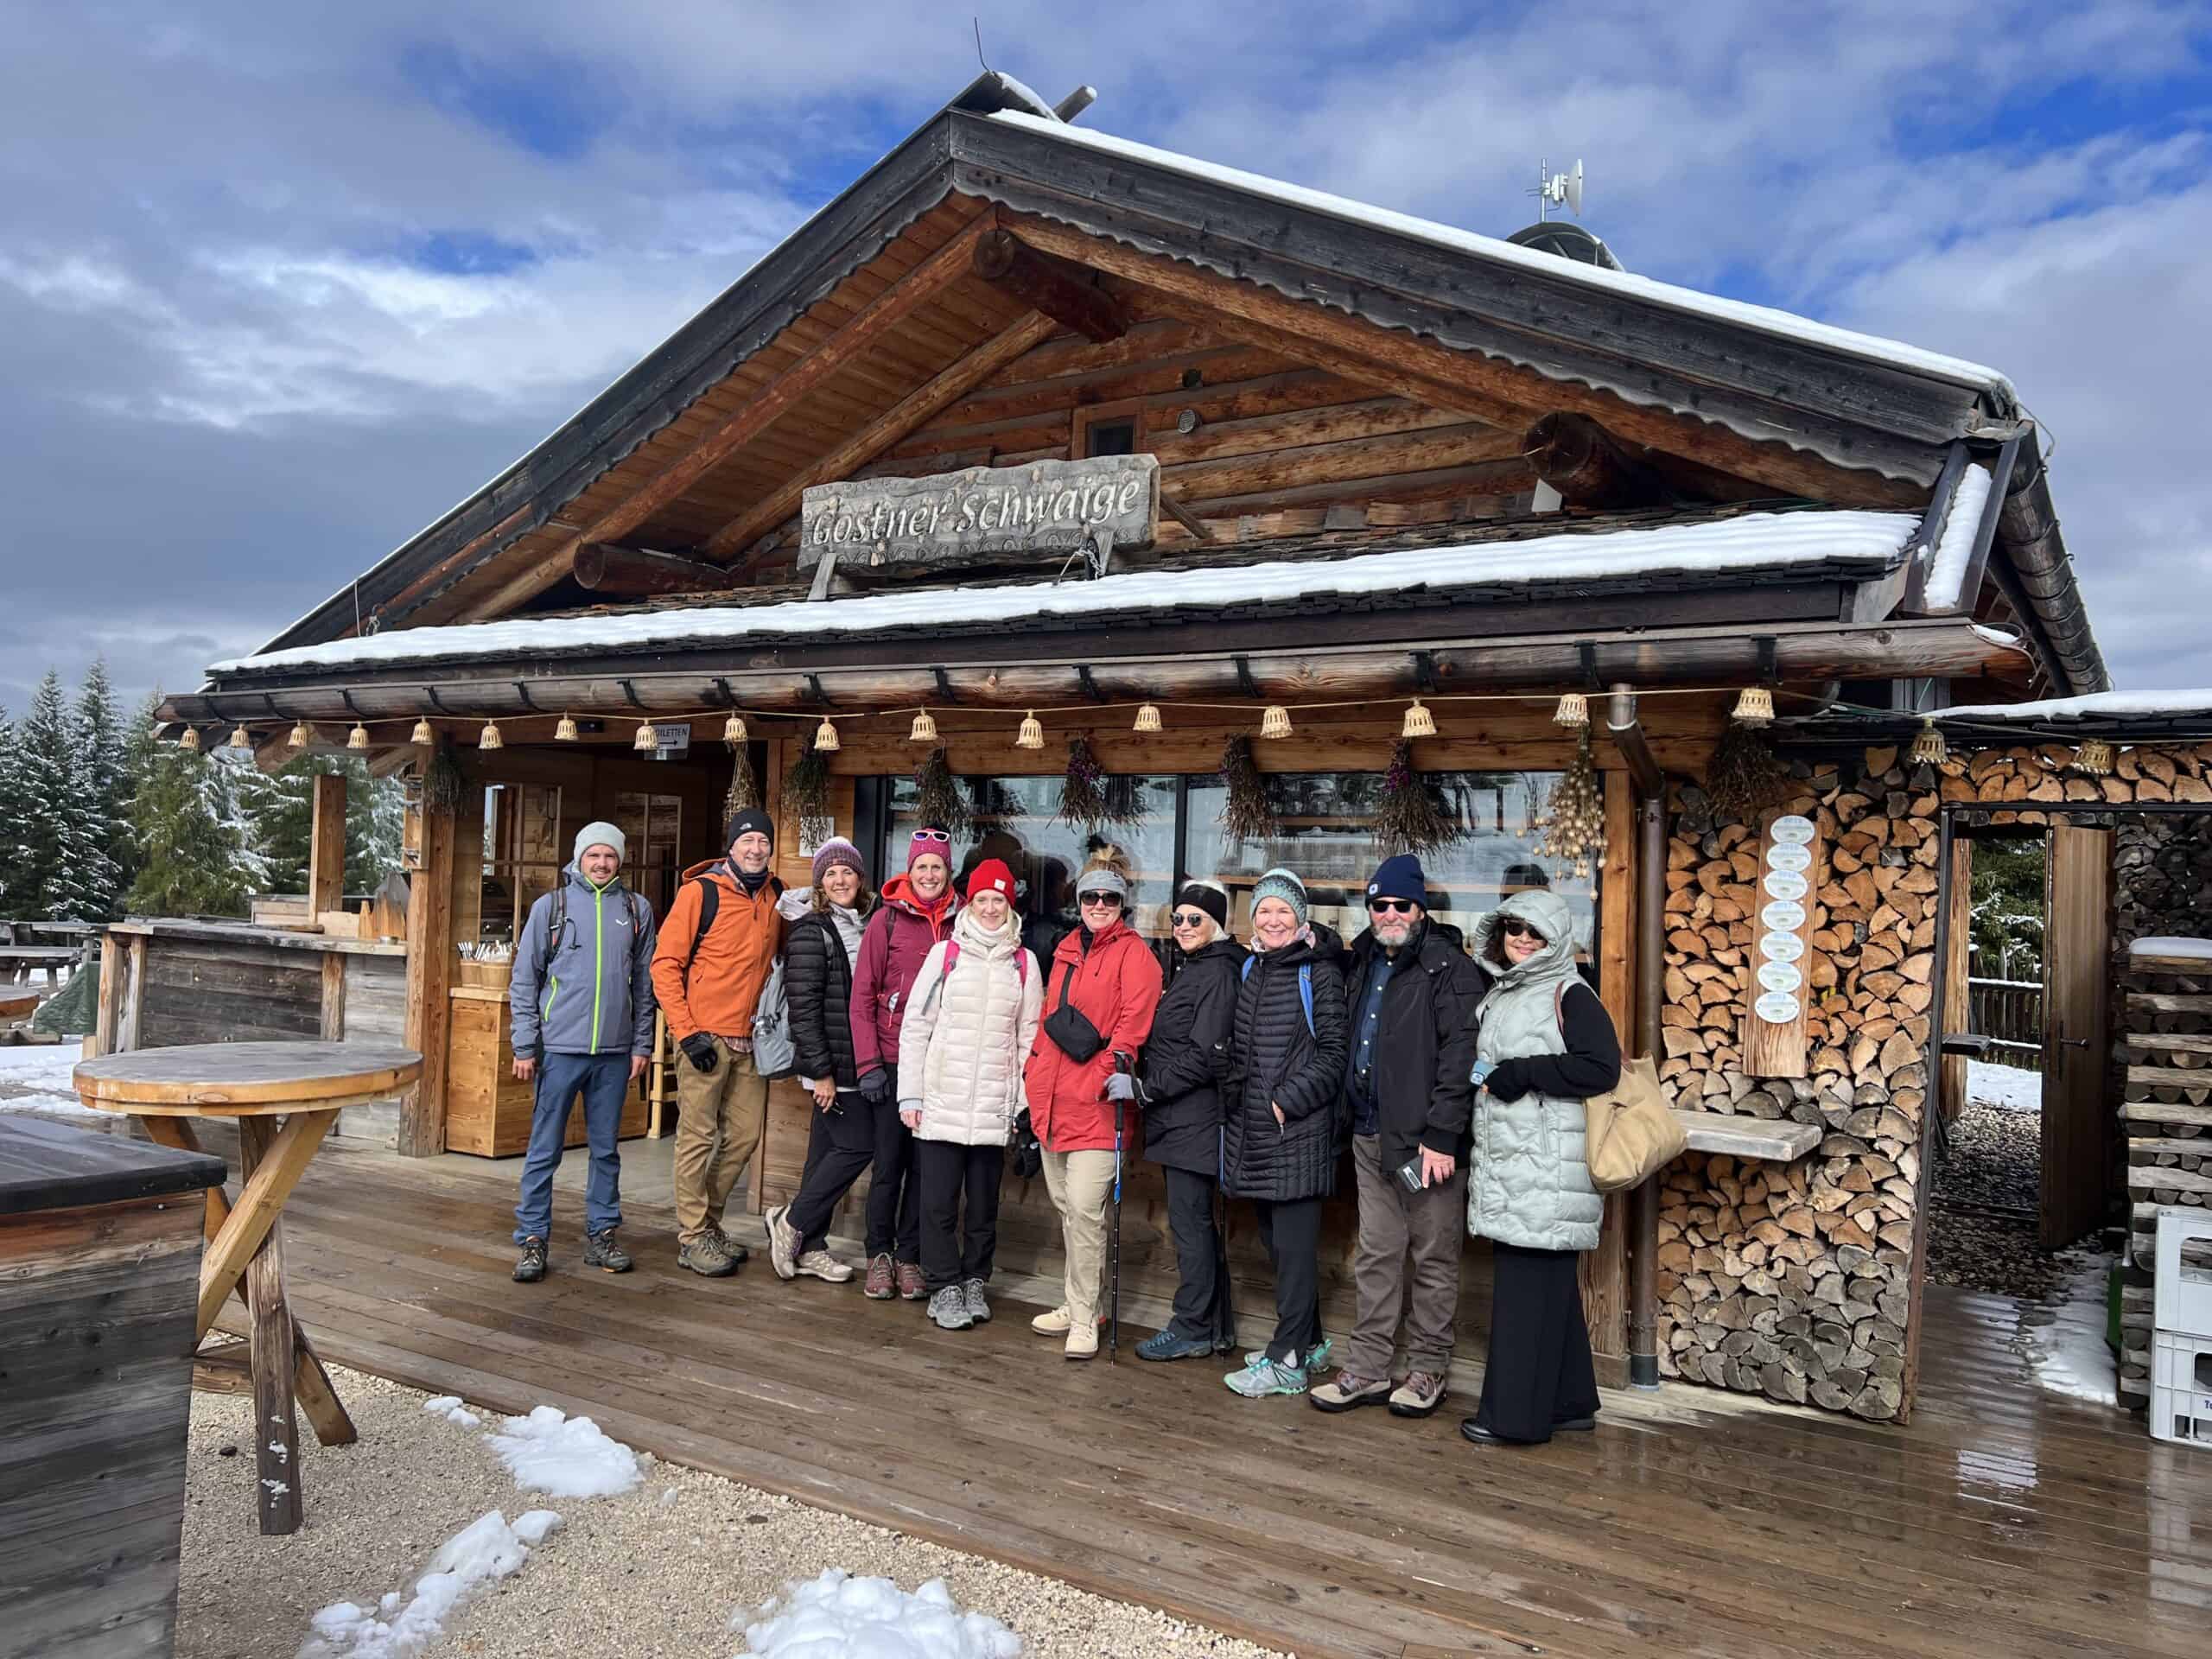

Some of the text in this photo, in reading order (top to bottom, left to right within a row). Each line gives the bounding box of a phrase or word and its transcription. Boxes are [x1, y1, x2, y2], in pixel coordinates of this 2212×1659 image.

[812, 477, 1141, 545] Gostner Schwaige
[655, 728, 688, 737] OILETTEN
